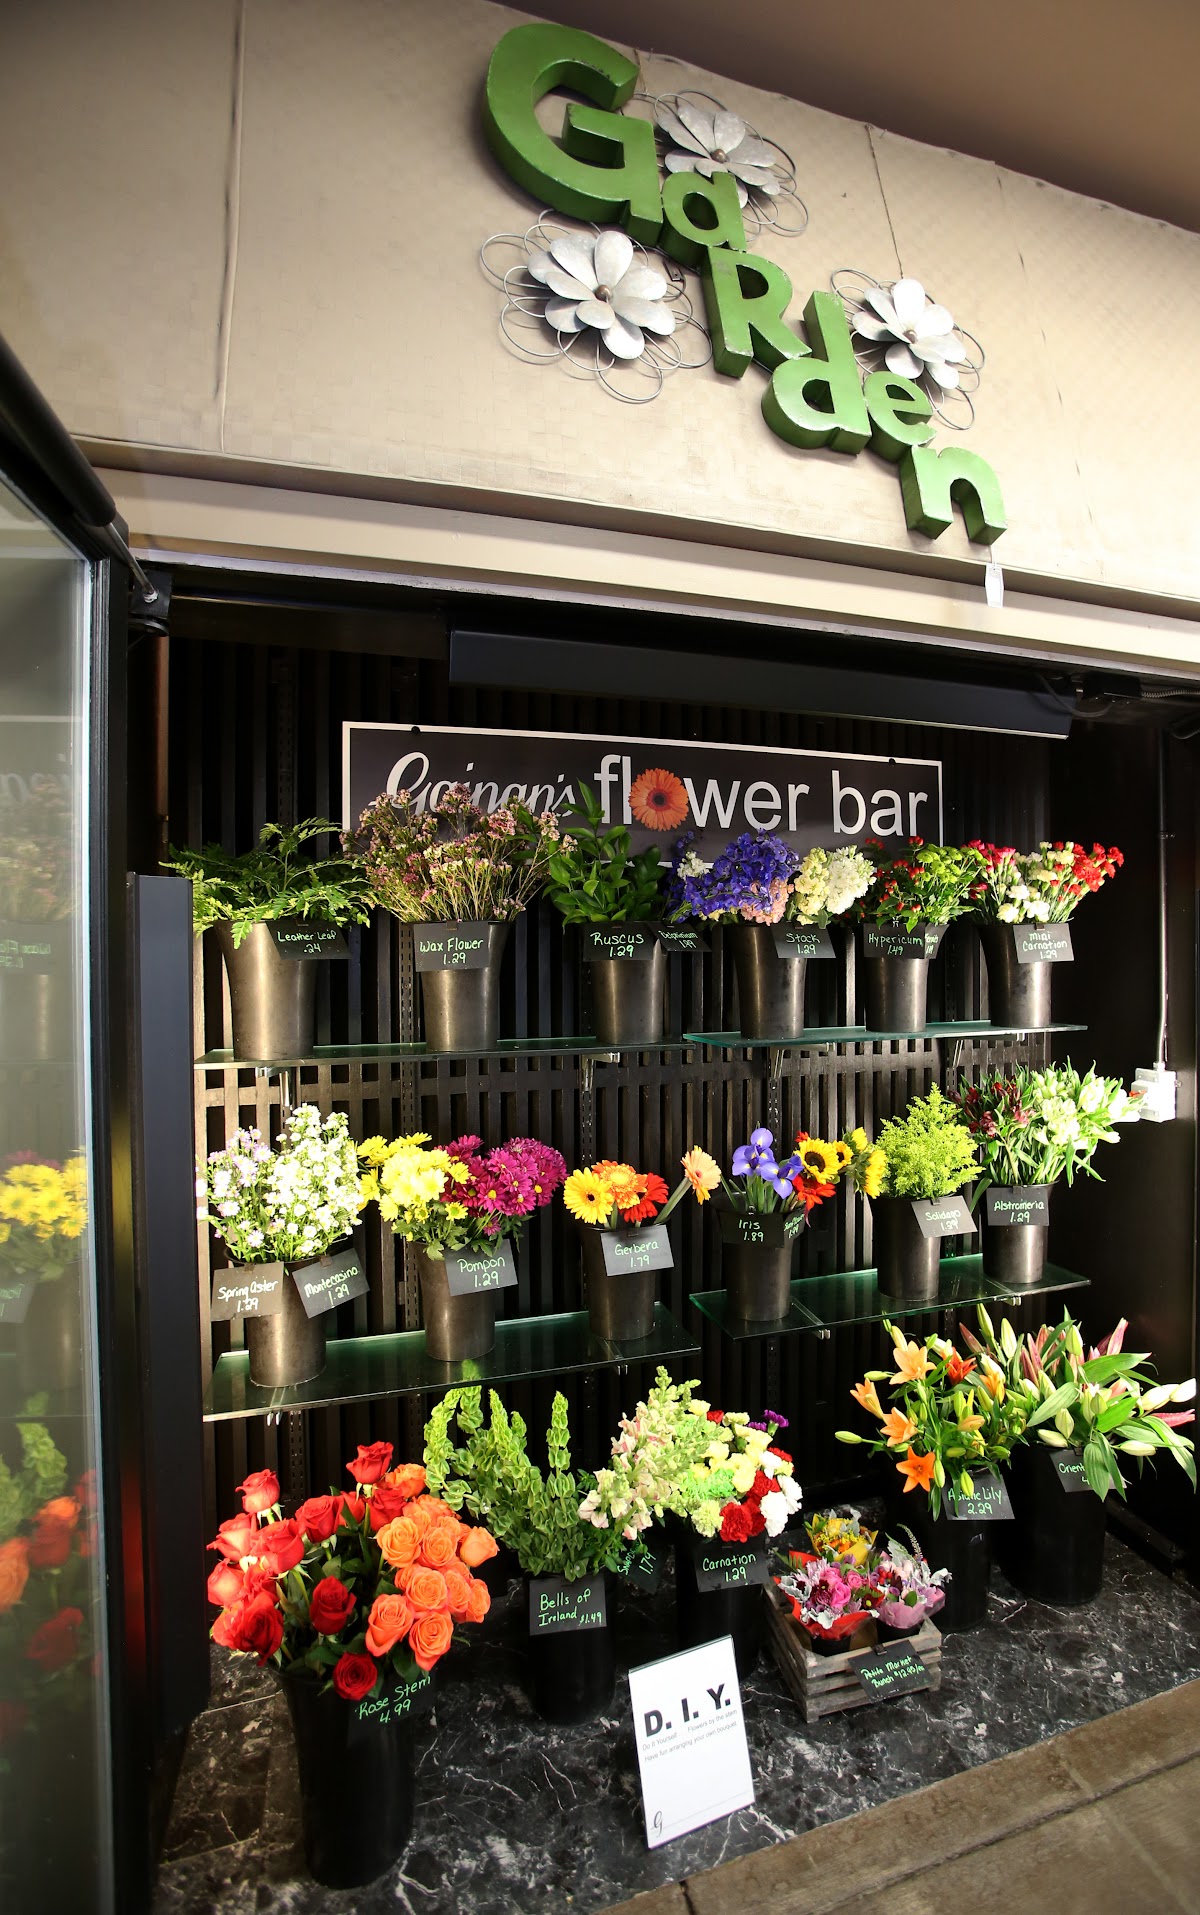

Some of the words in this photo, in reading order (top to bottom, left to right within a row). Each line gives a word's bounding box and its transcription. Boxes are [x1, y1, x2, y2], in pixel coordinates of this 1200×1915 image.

[832, 769, 929, 837] bar
[277, 930, 314, 942] Leather
[785, 932, 821, 944] Stock
[868, 932, 924, 947] Hypericum
[419, 941, 444, 953] Wax
[447, 937, 484, 952] Flower
[609, 945, 634, 958] 1.29
[797, 944, 816, 955] 1.29
[1022, 940, 1068, 952] Carnation
[443, 952, 467, 965] 1.29
[1039, 949, 1058, 960] 1.29
[925, 1209, 962, 1222] Solidago
[1009, 1211, 1031, 1223] 1.29
[738, 1219, 761, 1230] Iris
[743, 1231, 764, 1243] 1.89
[614, 1241, 660, 1256] Gerbera
[456, 1256, 505, 1273] Pompon
[630, 1254, 650, 1268] 1.79
[304, 1266, 360, 1298] Montecasino
[474, 1270, 499, 1288] 1.29
[217, 1285, 249, 1304] Spring
[328, 1283, 350, 1307] 1.29
[1059, 1462, 1086, 1474] Orient
[947, 1487, 982, 1501] Asiaic
[981, 1486, 1002, 1505] Lily
[967, 1502, 993, 1515] 2.29
[702, 1553, 757, 1572] Carnation
[724, 1566, 747, 1583] 1.29
[540, 1591, 570, 1611] Bells
[577, 1588, 592, 1602] of
[538, 1605, 578, 1627] Ireland
[355, 1697, 390, 1720] Rose
[393, 1675, 431, 1702] Stem
[379, 1698, 412, 1724] 4.99
[643, 1709, 672, 1738] D.
[681, 1697, 699, 1723] I.
[706, 1682, 731, 1711] Y.
